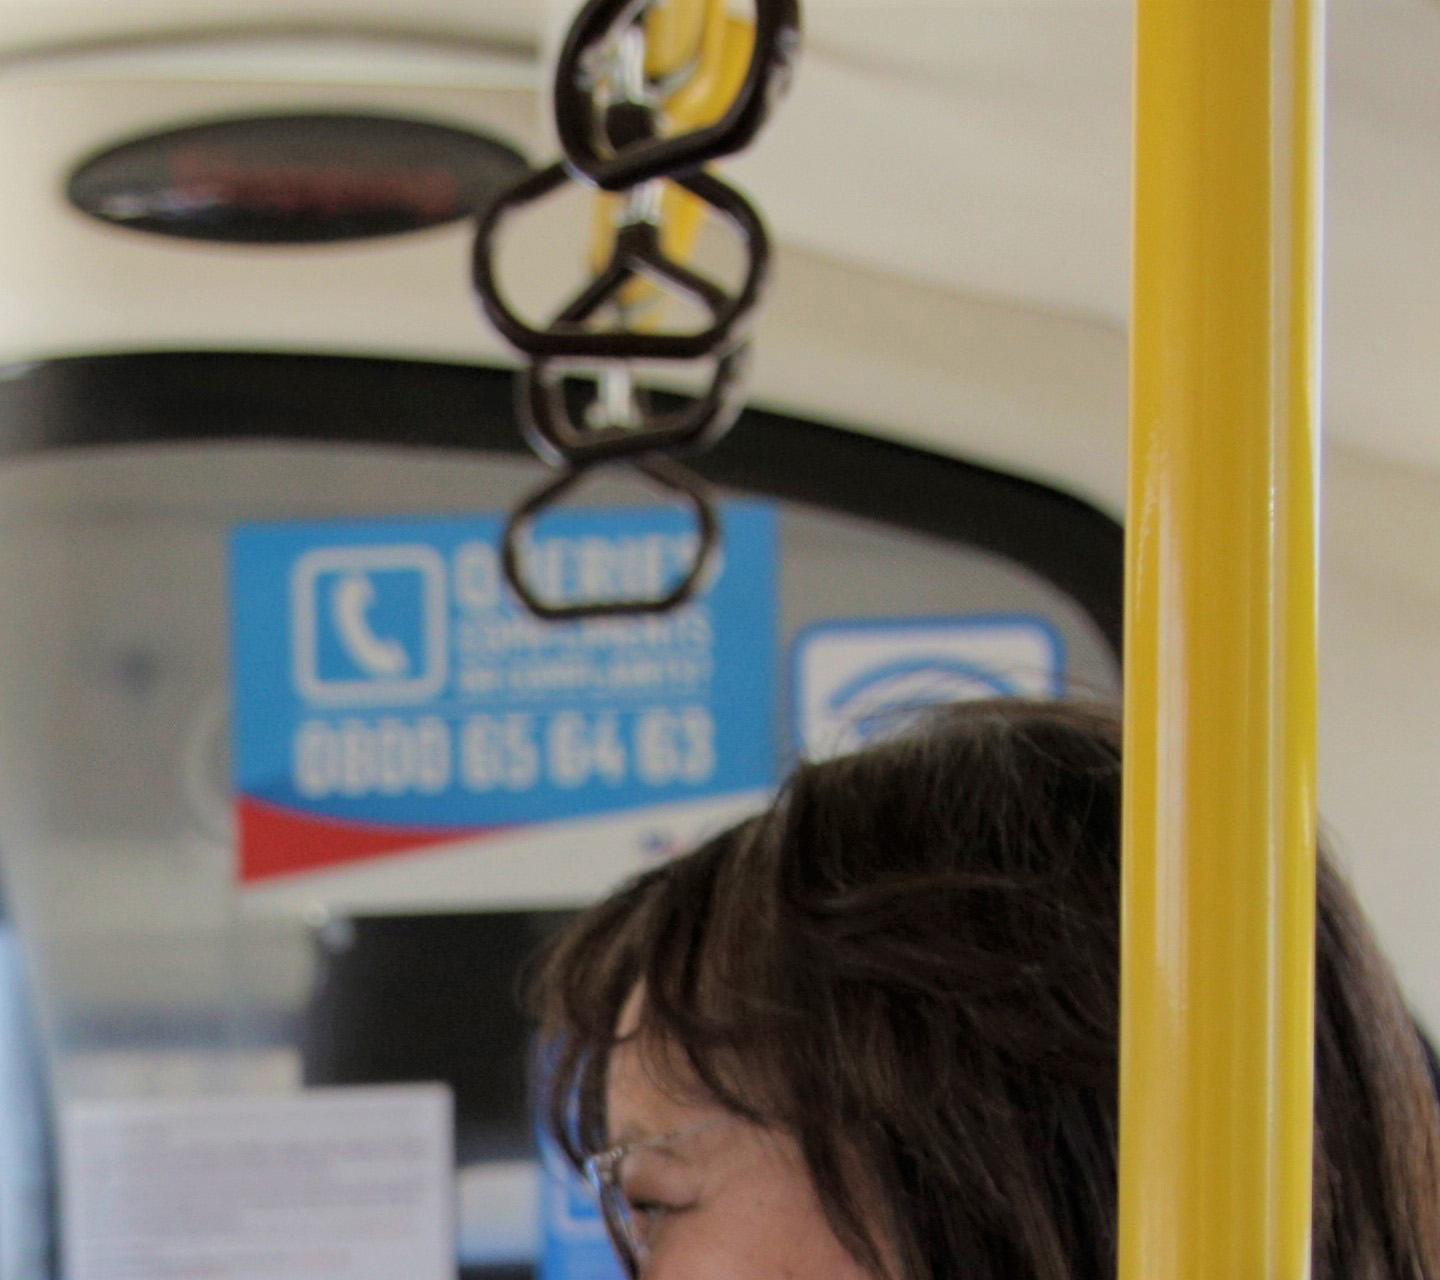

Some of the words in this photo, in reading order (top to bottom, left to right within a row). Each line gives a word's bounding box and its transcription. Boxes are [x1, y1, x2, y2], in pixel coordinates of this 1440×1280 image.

[293, 715, 453, 798] 0800
[458, 712, 539, 791] 65
[547, 709, 628, 788] 64
[633, 706, 716, 786] 63
